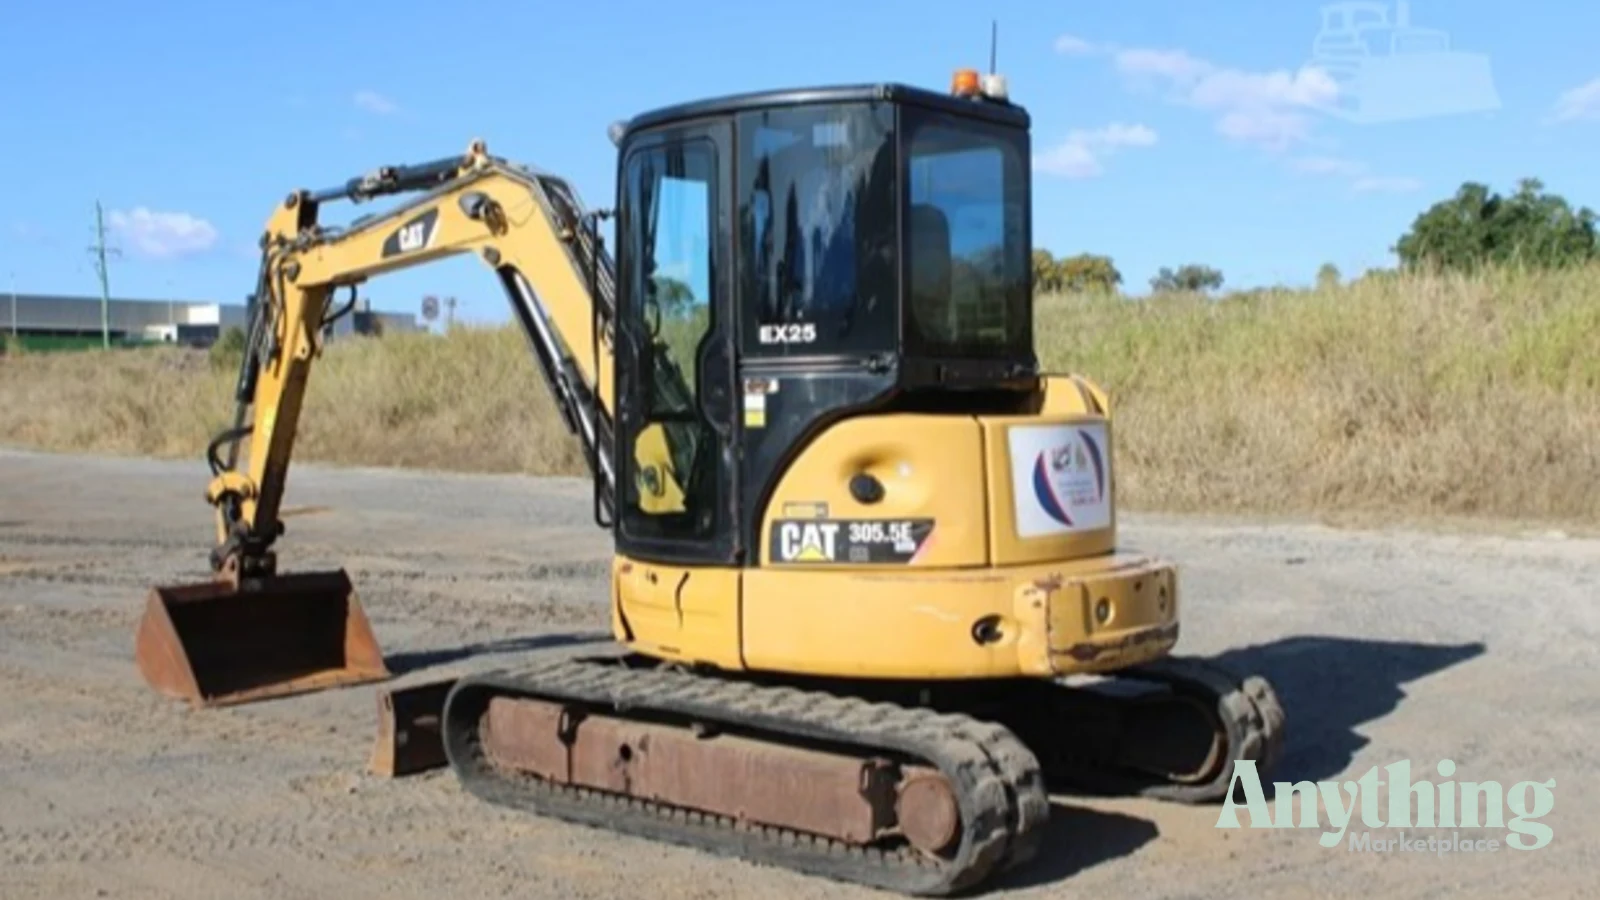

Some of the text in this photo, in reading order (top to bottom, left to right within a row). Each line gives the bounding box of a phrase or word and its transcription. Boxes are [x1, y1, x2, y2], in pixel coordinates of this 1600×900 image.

[398, 222, 424, 250] CAT
[759, 323, 816, 344] EX25
[781, 522, 839, 561] CAT
[848, 522, 912, 543] 305.5E
